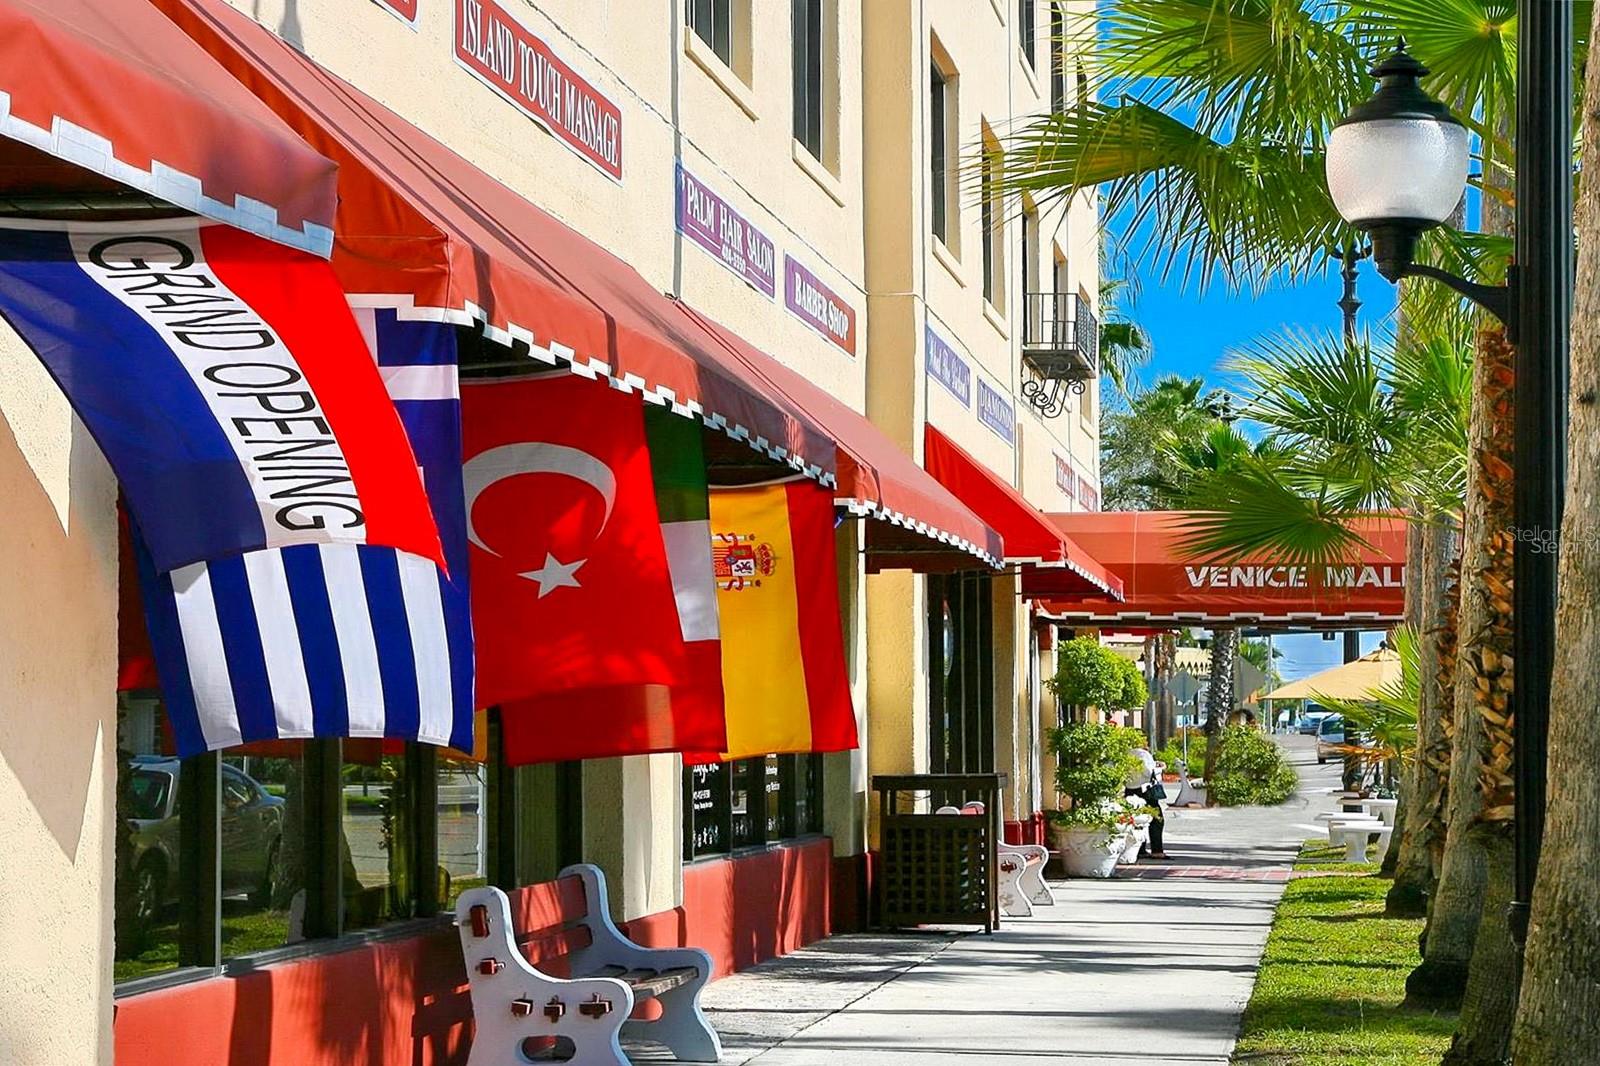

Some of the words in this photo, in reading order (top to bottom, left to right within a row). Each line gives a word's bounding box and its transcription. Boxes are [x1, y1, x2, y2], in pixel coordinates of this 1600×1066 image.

[462, 0, 515, 84] ISLAND
[518, 39, 562, 125] TOUCH
[564, 79, 619, 167] MASSAGE
[687, 177, 715, 232] PALM
[720, 204, 743, 254] HAIR
[747, 227, 774, 278] SALON
[794, 272, 828, 320] BARBER
[828, 300, 849, 340] SHOP
[88, 236, 275, 350] GRAND
[203, 363, 365, 530] OPENING
[1184, 566, 1307, 587] VENICE
[1323, 566, 1406, 587] MAL
